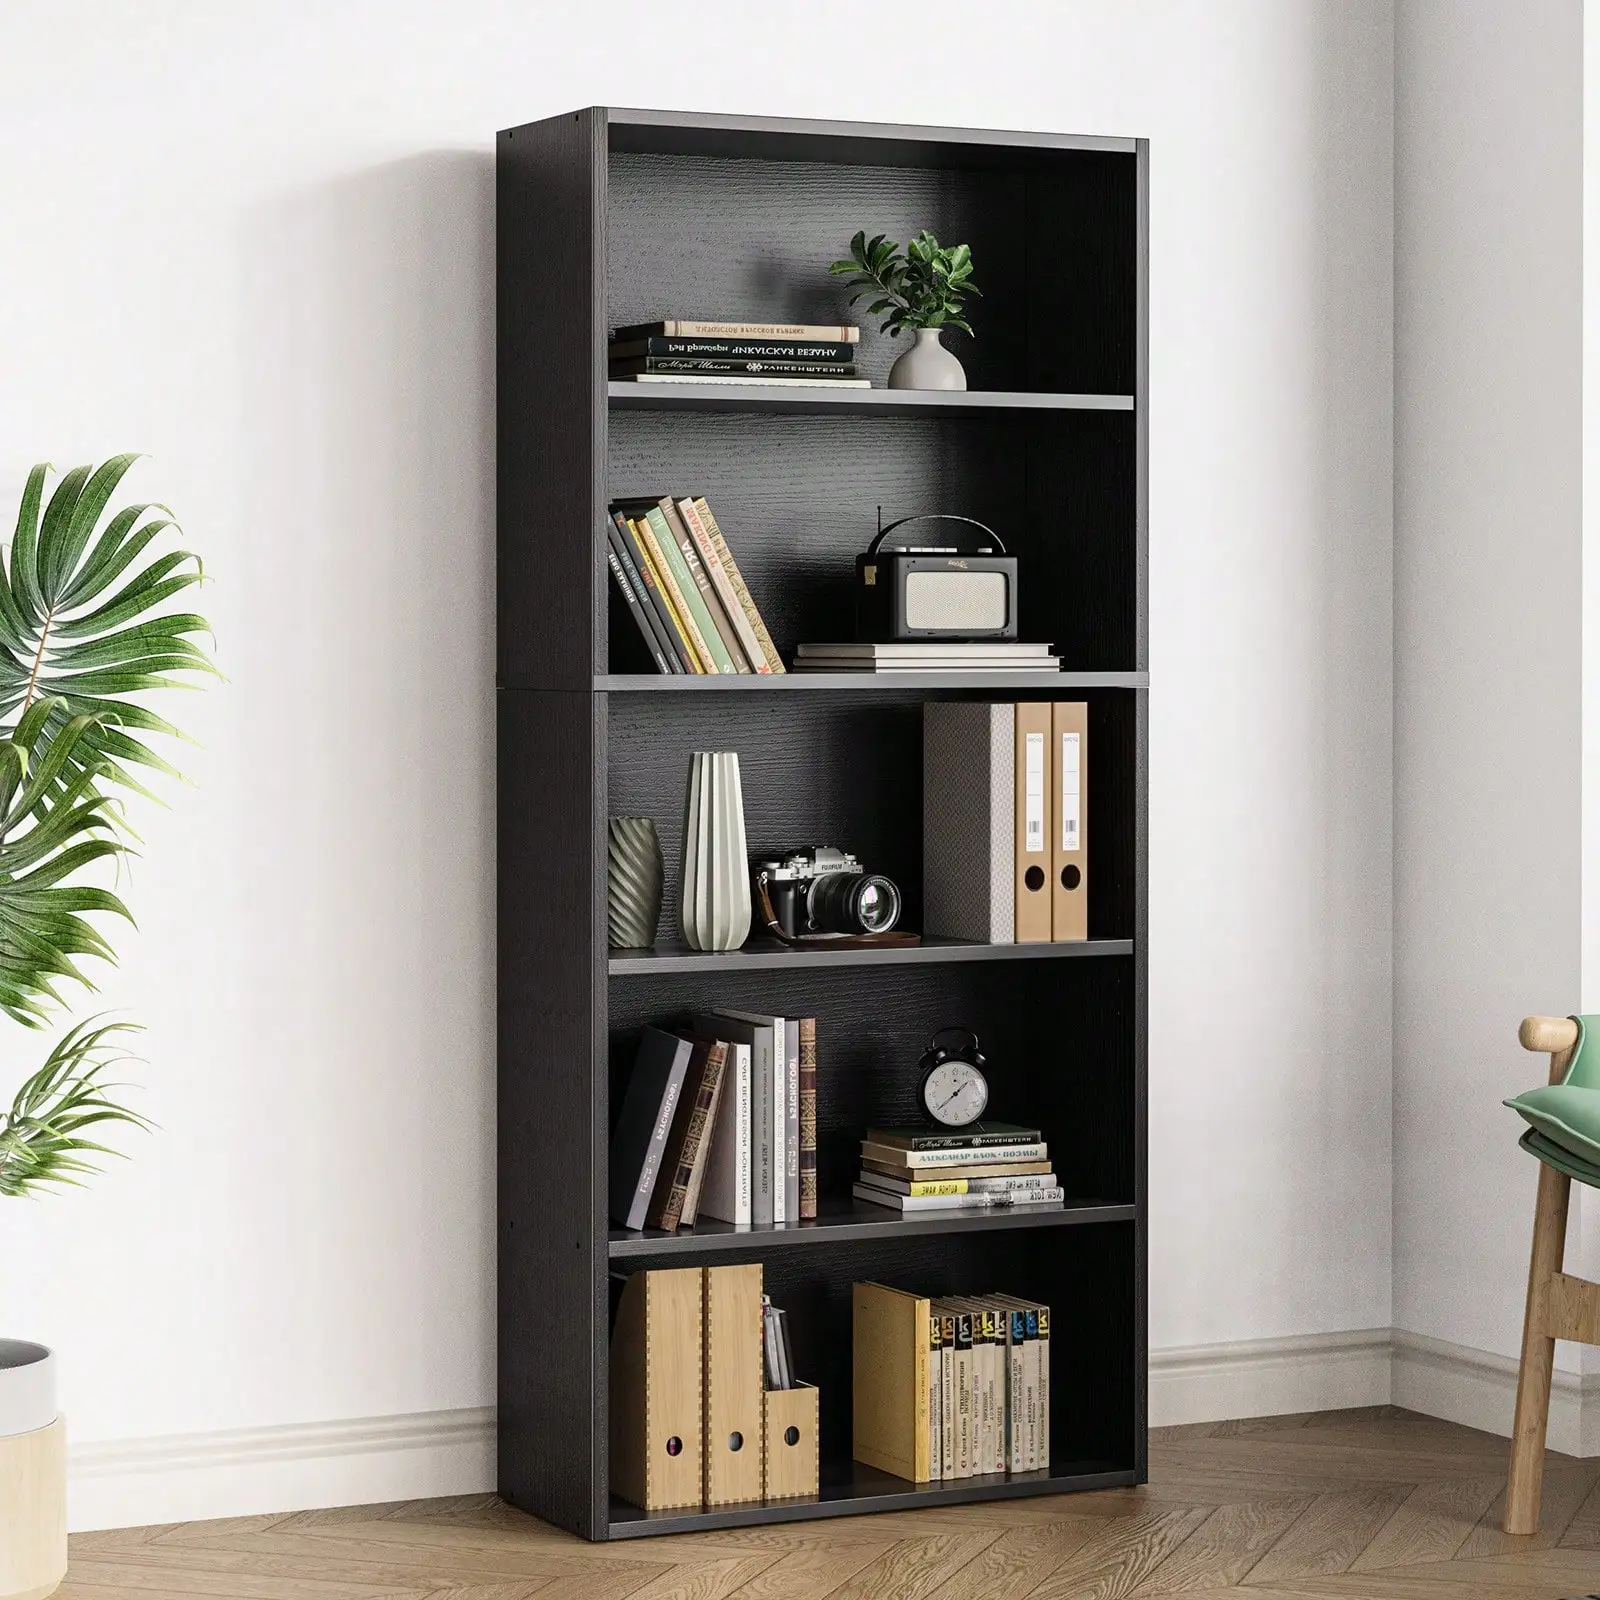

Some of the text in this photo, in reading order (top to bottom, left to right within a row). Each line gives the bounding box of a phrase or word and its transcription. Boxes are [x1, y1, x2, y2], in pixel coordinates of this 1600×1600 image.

[918, 1149, 1039, 1162] АЛЕКСАНДР БЛОК ПОЭМЫ
